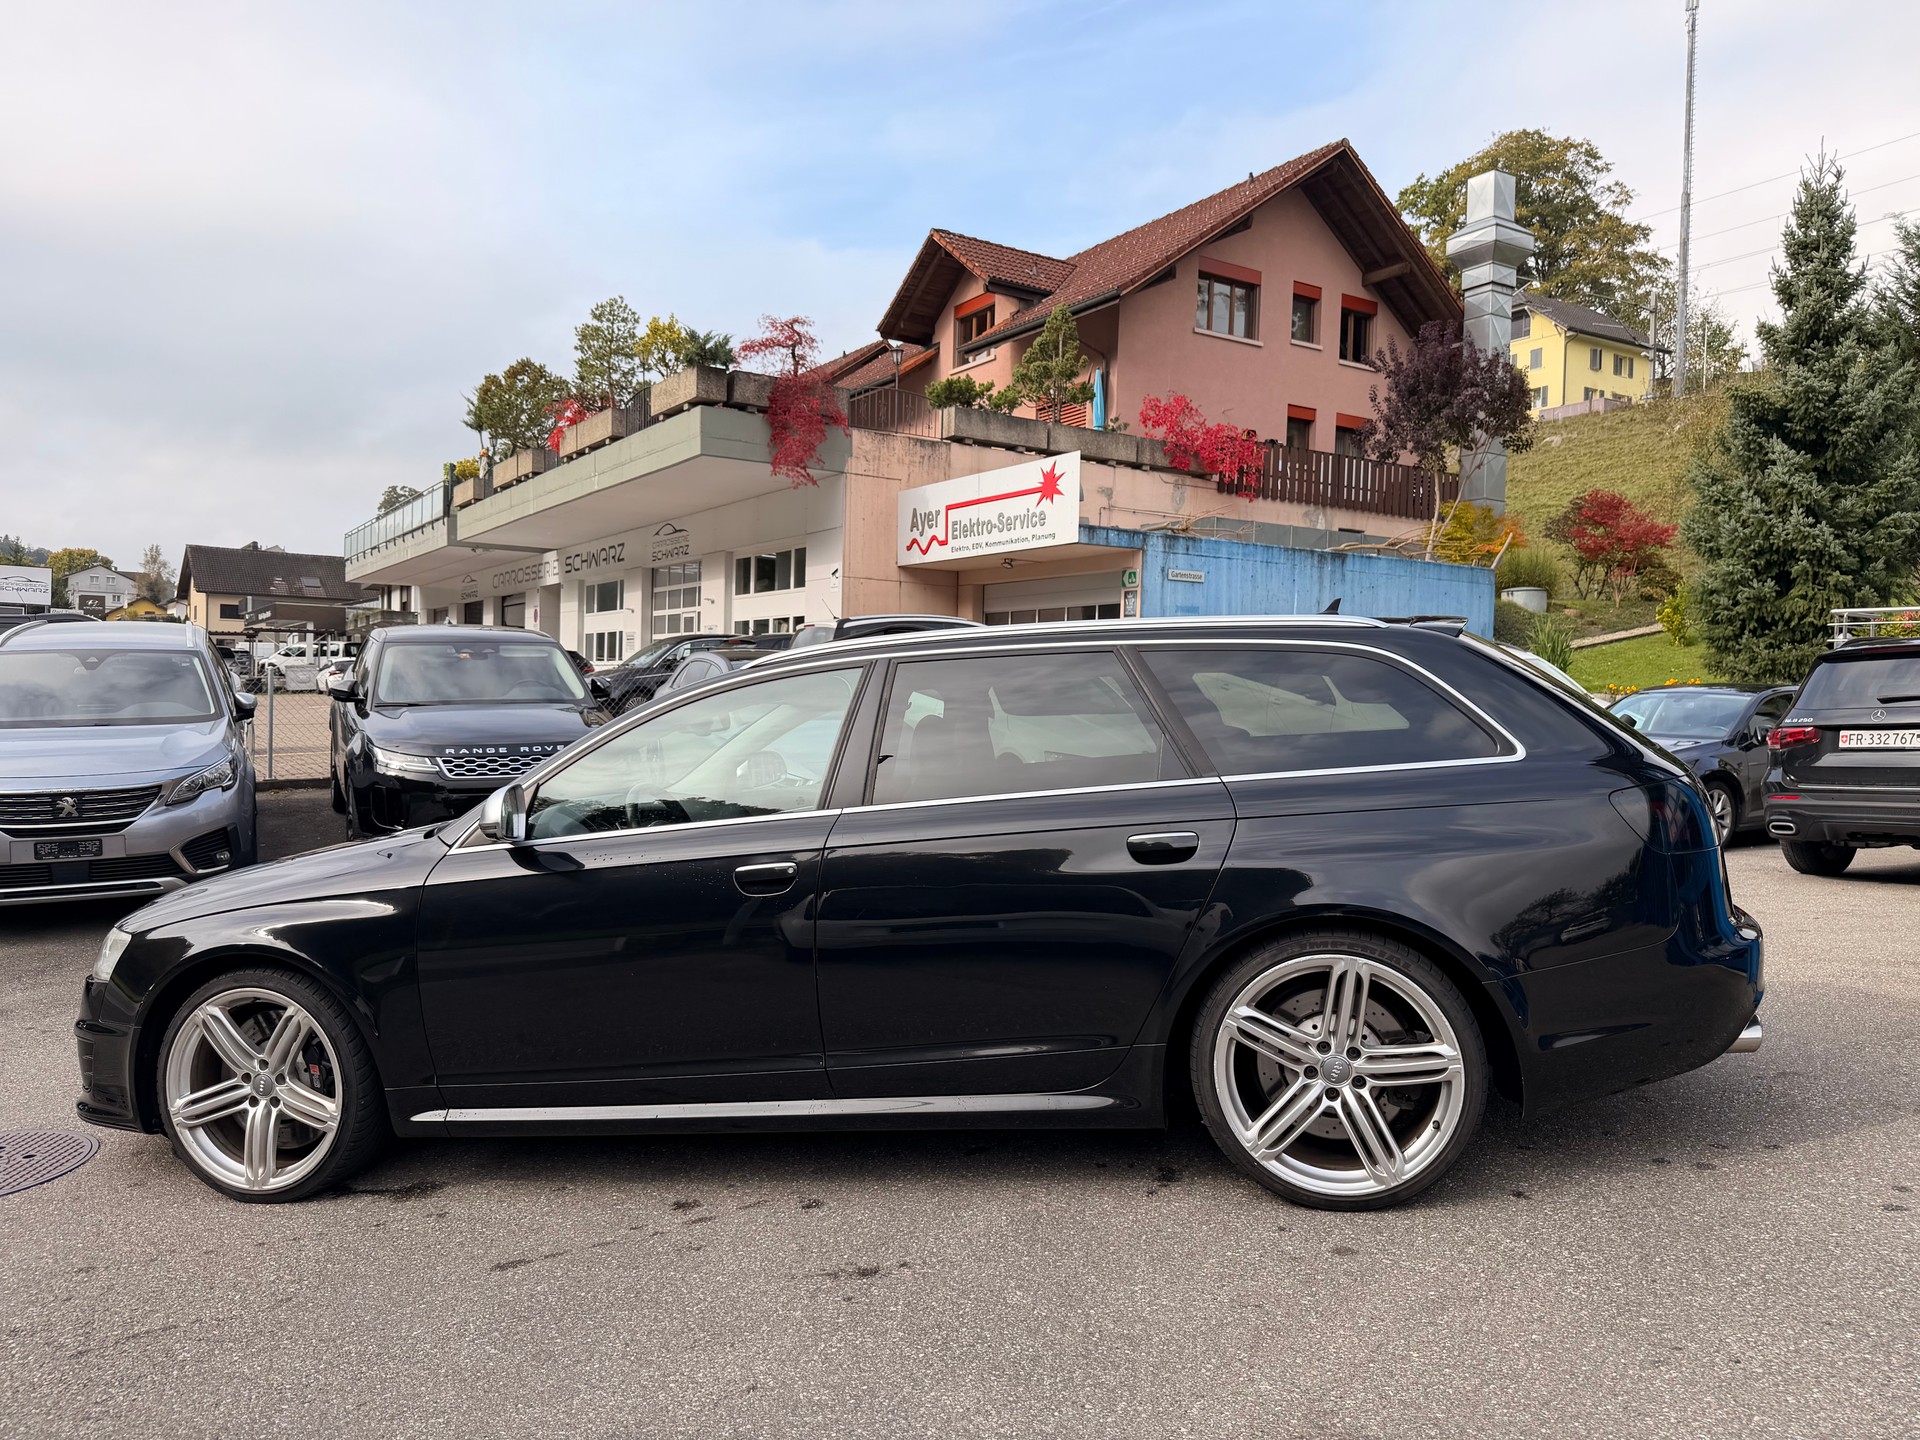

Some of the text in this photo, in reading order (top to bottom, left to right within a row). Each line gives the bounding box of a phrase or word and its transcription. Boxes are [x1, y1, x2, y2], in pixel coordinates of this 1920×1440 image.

[910, 507, 941, 537] Ayer
[951, 508, 1047, 540] Elektro-Service
[652, 544, 690, 562] SCHWARZ
[951, 544, 971, 553] Elektro,
[985, 536, 1031, 548] Kommunikation,
[1031, 532, 1056, 542] Planung
[492, 542, 625, 589] CARROSSERIE SCHWARZ
[1170, 571, 1203, 580] Gartenstrasse
